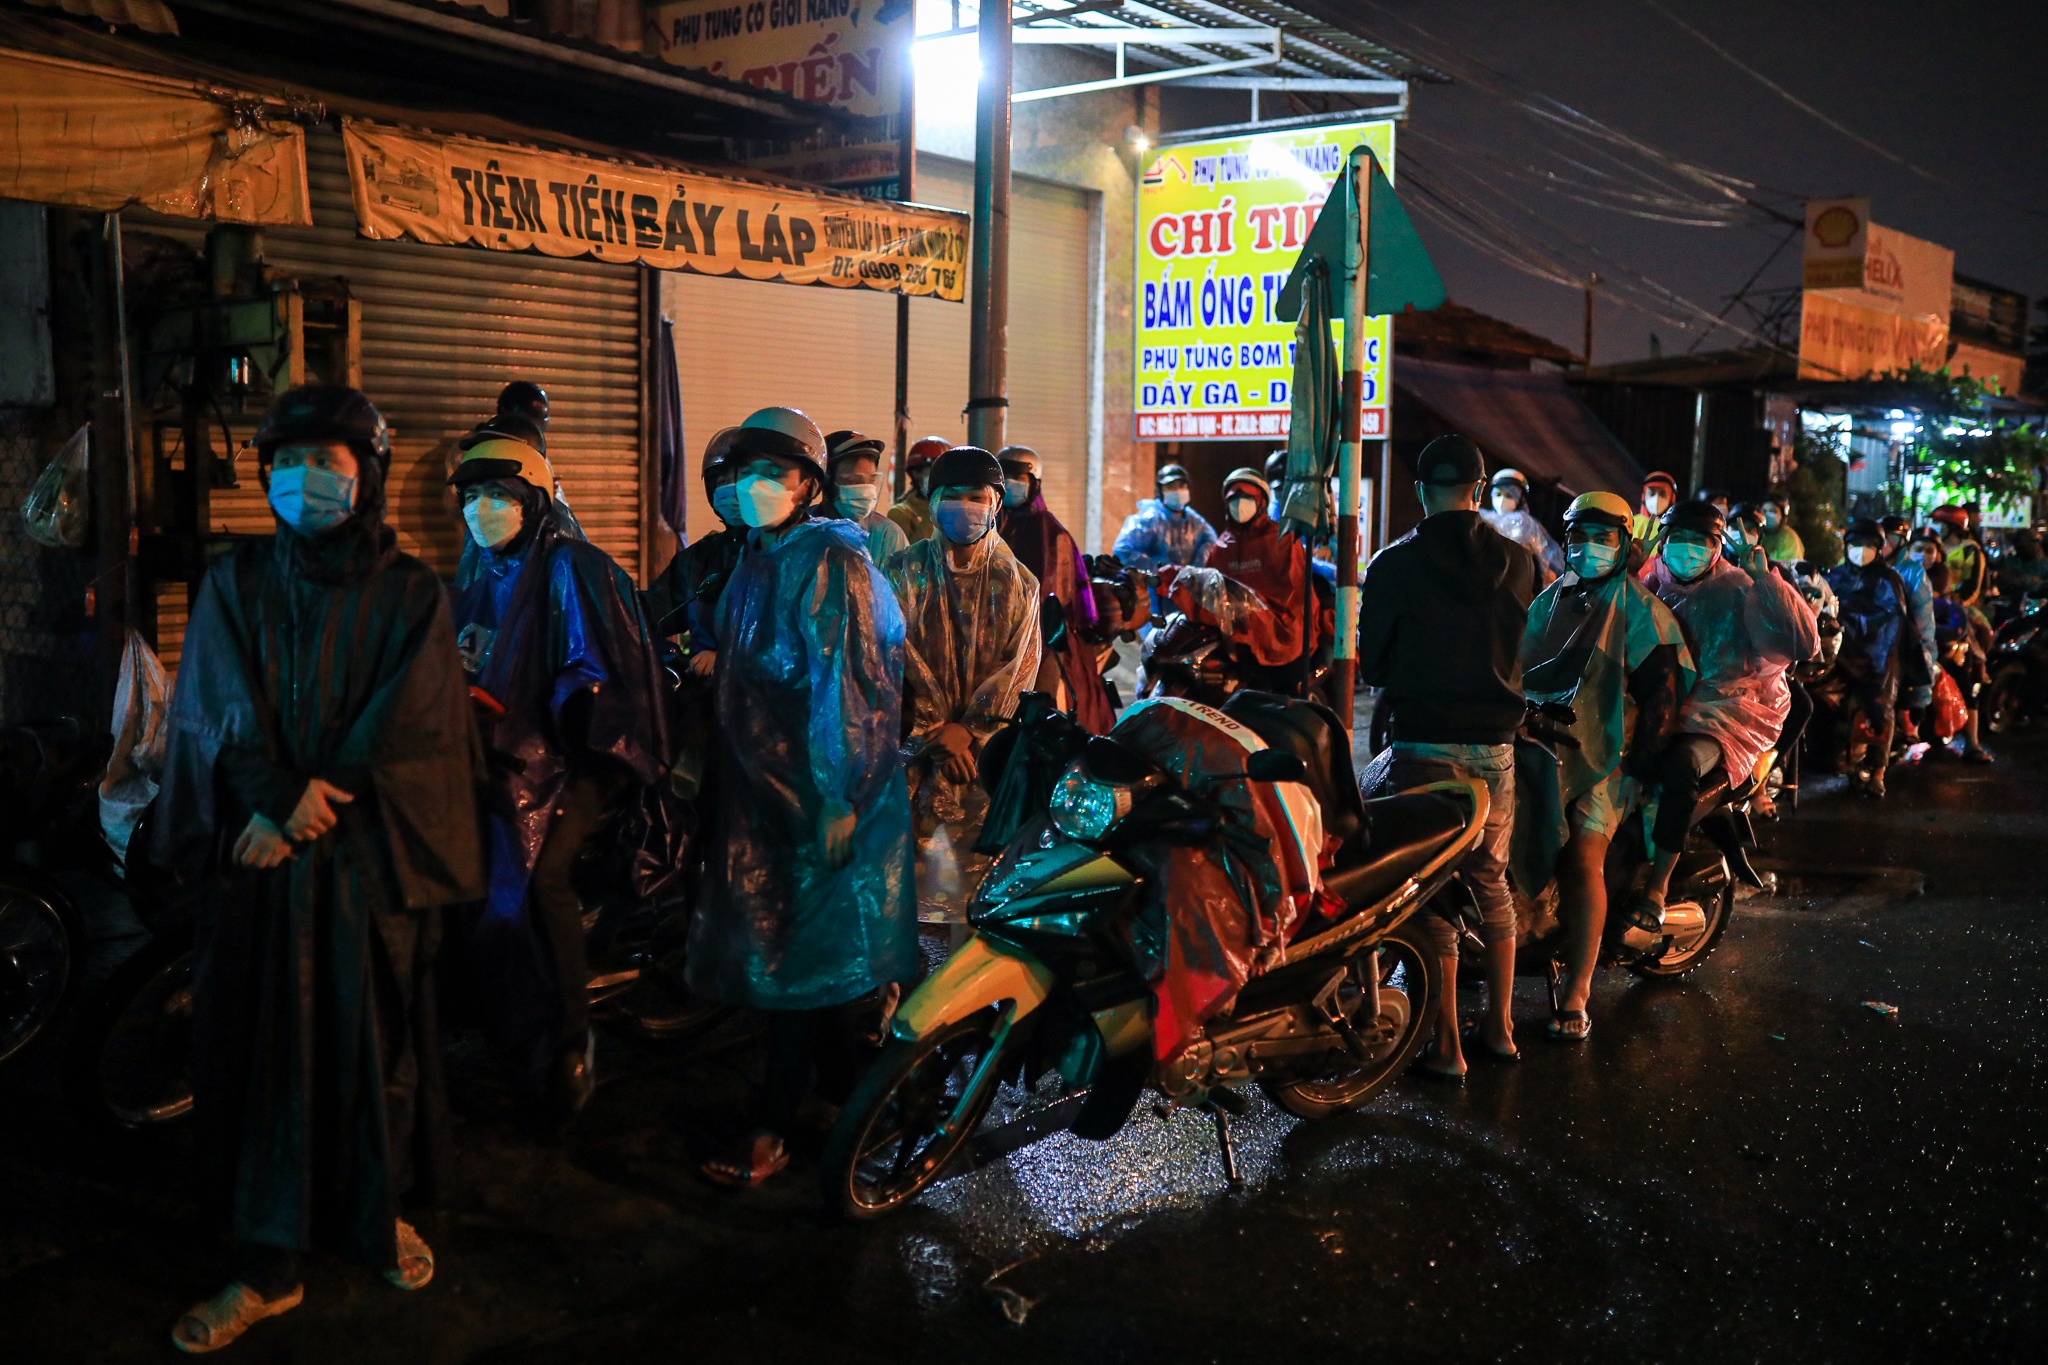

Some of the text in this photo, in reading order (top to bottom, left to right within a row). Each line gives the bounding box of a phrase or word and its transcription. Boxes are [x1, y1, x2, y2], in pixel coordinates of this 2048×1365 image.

[451, 160, 547, 243] TIỆM
[549, 173, 627, 254] TIỆN
[631, 184, 724, 256] BẢY
[736, 203, 816, 267] LÁP
[1150, 199, 1234, 256] CHÍ
[859, 259, 901, 281] 0908
[1145, 264, 1192, 328] BẤM
[1202, 260, 1253, 326] ỐNG
[1144, 347, 1177, 375] PHỤ
[1144, 379, 1192, 406] DÂY
[1205, 384, 1238, 405] GA
